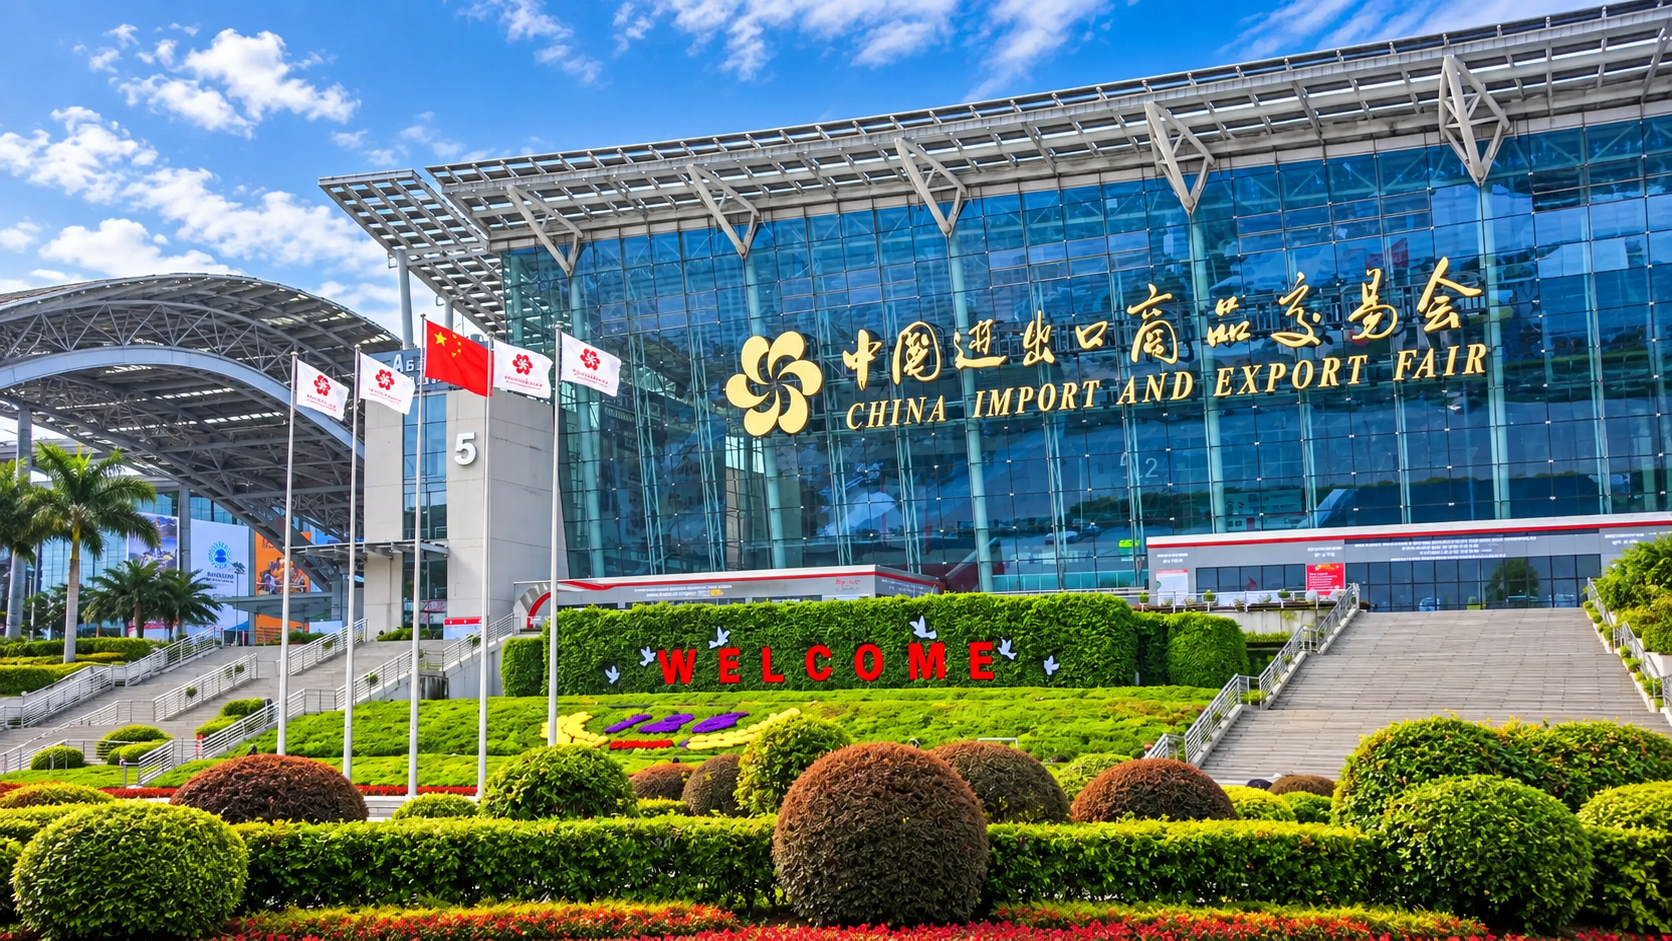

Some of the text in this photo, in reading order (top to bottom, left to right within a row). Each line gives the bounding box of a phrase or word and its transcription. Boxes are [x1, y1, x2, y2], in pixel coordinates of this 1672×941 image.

[846, 343, 1487, 431] CHINA IMPORT AND EXPORT FAIR
[454, 431, 477, 466] 5
[657, 640, 996, 686] WELCOME
